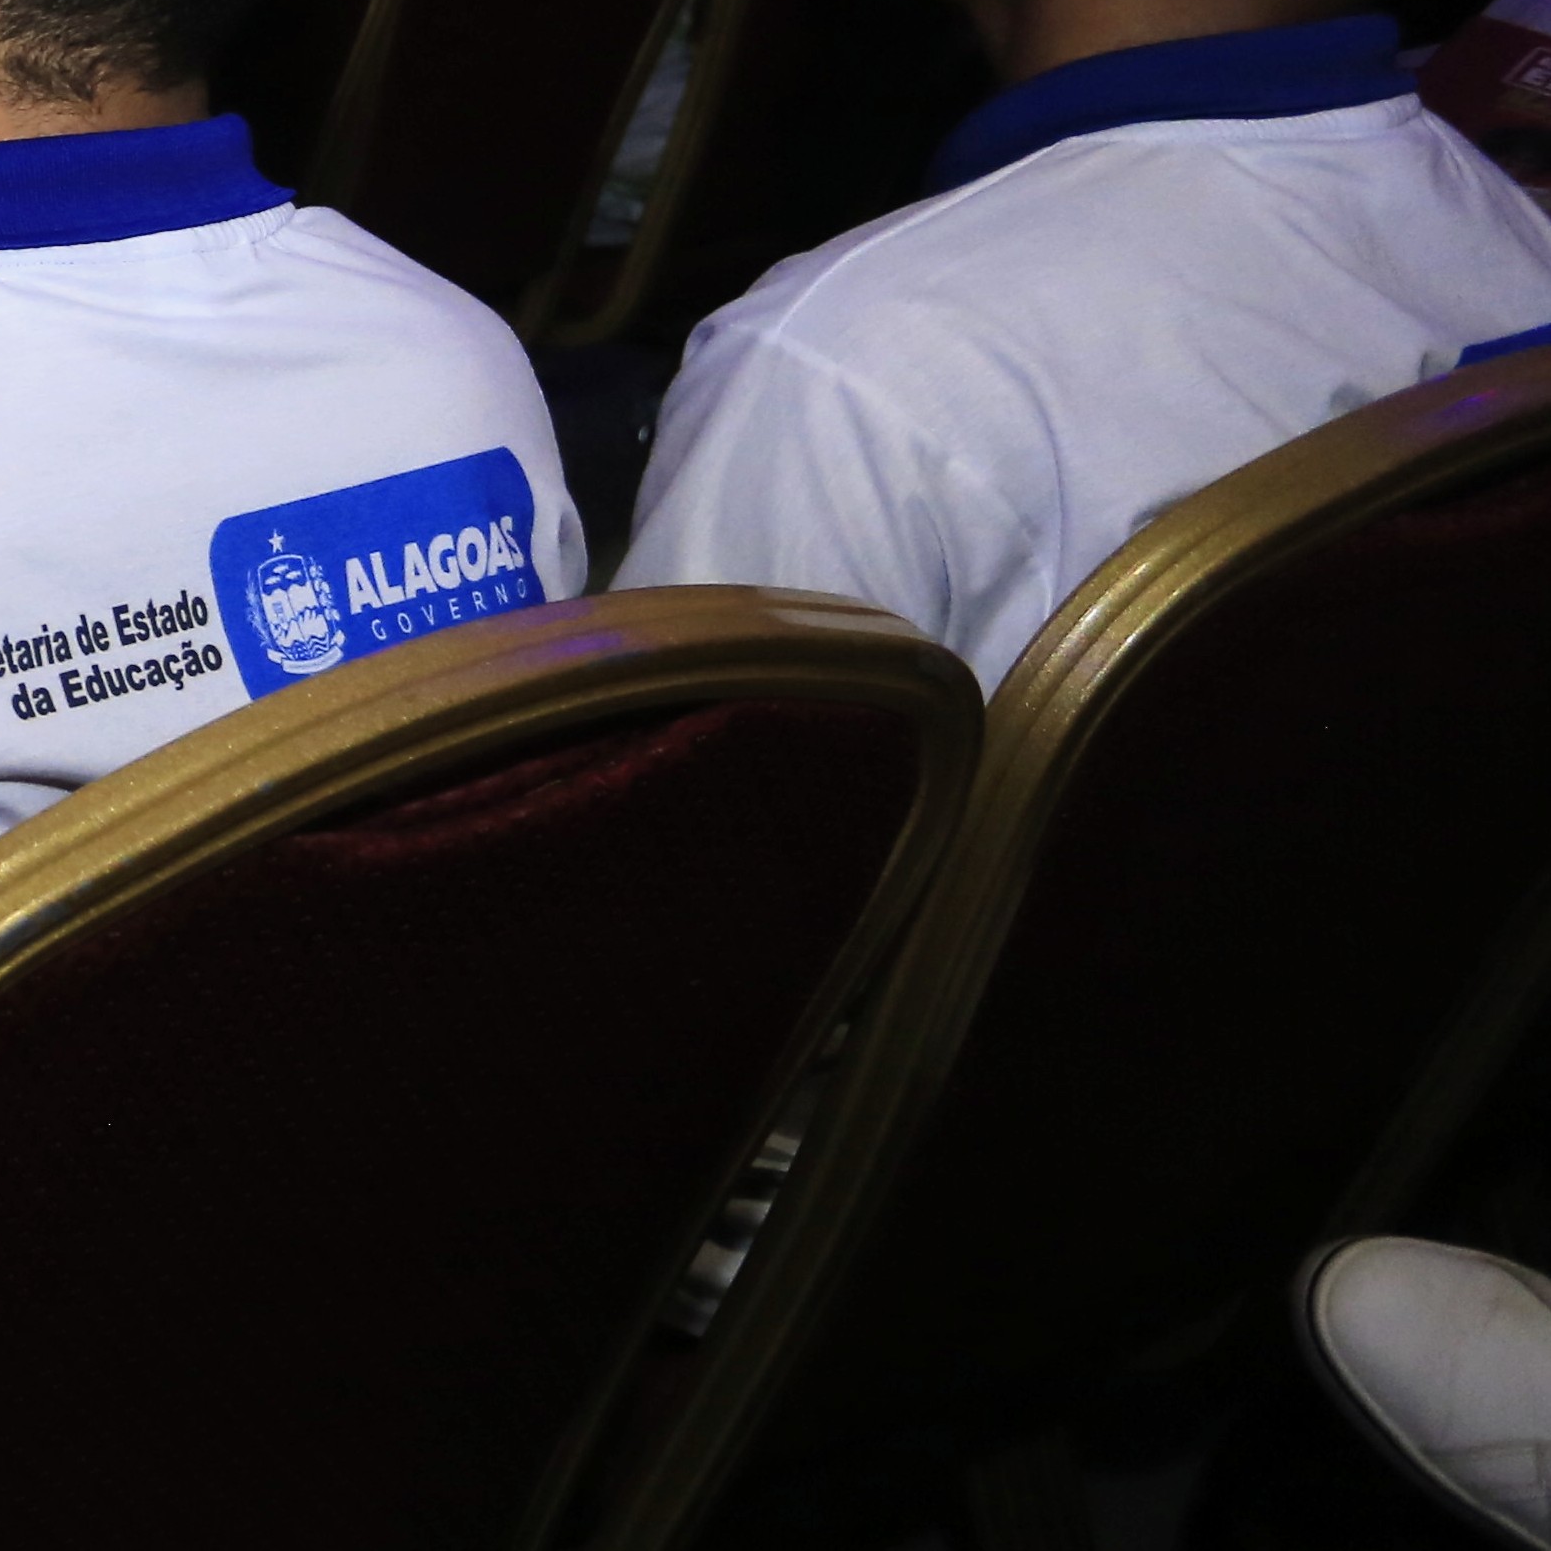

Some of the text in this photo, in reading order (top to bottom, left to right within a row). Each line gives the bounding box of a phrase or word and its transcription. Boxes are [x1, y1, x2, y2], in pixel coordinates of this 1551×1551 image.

[345, 515, 525, 615] ALAGOAS
[75, 614, 110, 657] de
[112, 589, 209, 647] Estado
[371, 578, 527, 641] GOVERNO
[11, 640, 223, 721] da Educação
